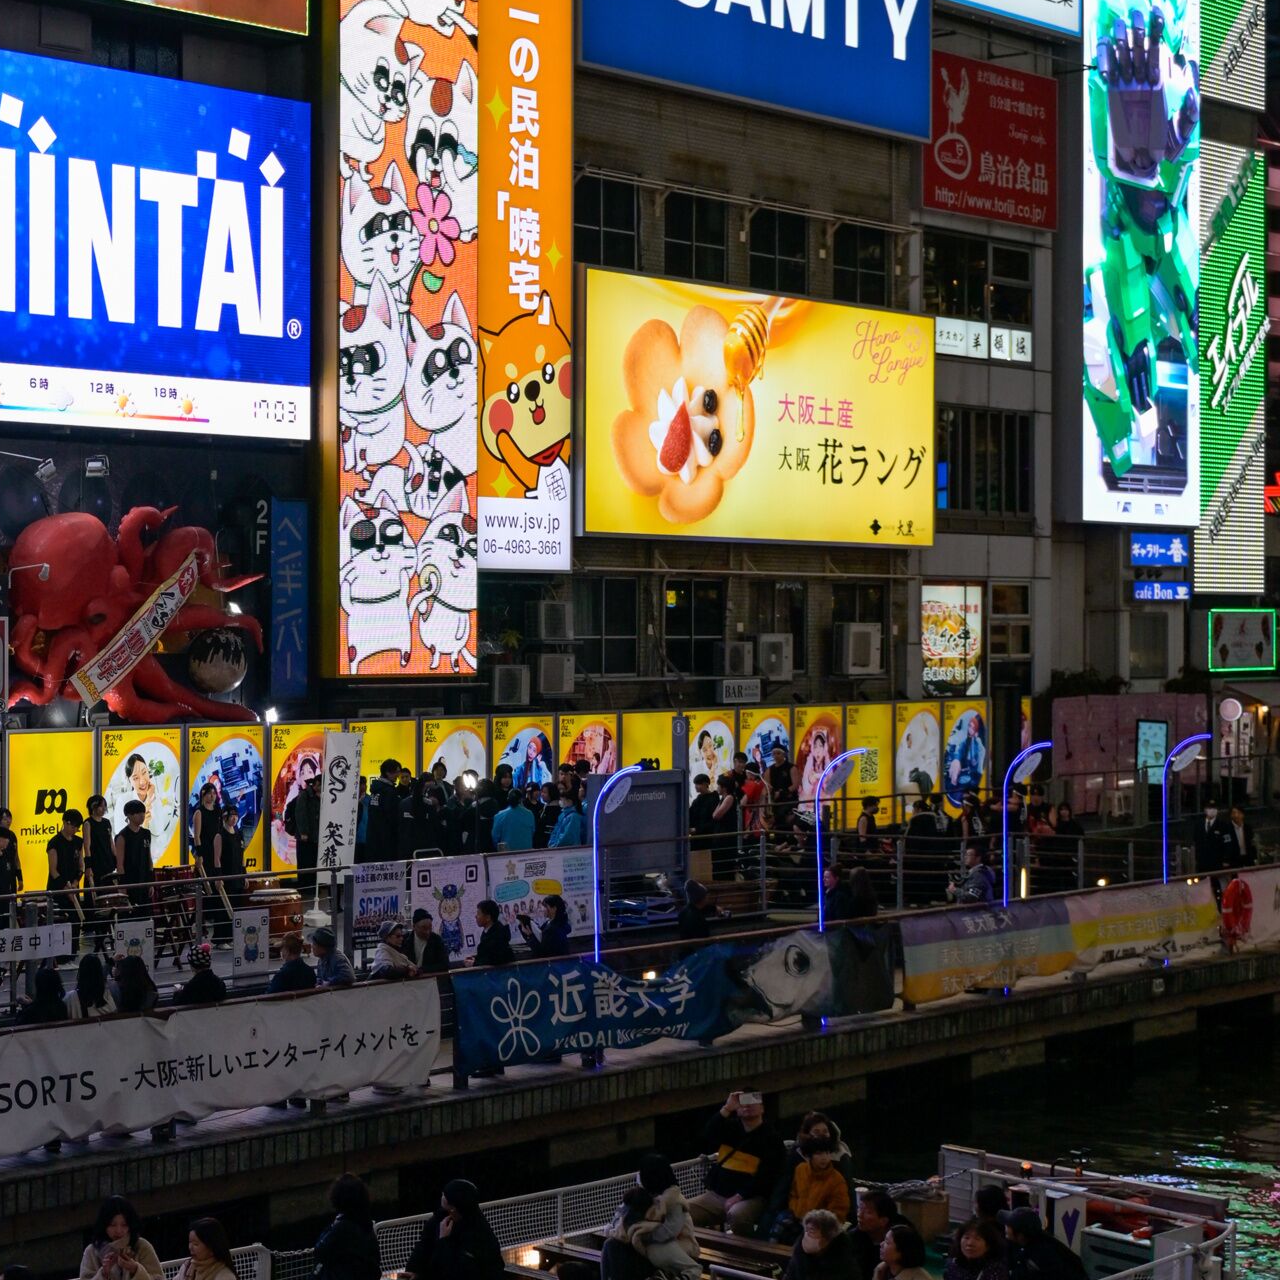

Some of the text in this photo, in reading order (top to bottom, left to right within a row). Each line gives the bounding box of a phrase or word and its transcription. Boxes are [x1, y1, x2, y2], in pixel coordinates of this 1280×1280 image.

[978, 151, 1049, 195] 鳥治食品
[935, 186, 1047, 223] http://www.toriji.co.jp/
[853, 320, 901, 360] Hana
[935, 329, 964, 342] ギスカン
[1207, 252, 1259, 409] エイブル
[868, 352, 926, 385] Langue
[29, 376, 48, 391] 6時
[89, 381, 115, 396] 12時
[154, 386, 178, 401] 18時
[778, 392, 855, 429] 大阪土産
[778, 446, 810, 472] 大阪
[817, 437, 926, 490] 花ラング
[256, 499, 269, 555] 2F
[484, 511, 560, 534] www.jsv.jp
[482, 538, 562, 556] 06-4963-3661
[1132, 542, 1166, 558] ギャラリー
[1135, 583, 1173, 599] café Bon
[725, 685, 743, 698] BAR
[359, 894, 399, 916] SCRUM
[548, 967, 696, 1026] 近畿大学
